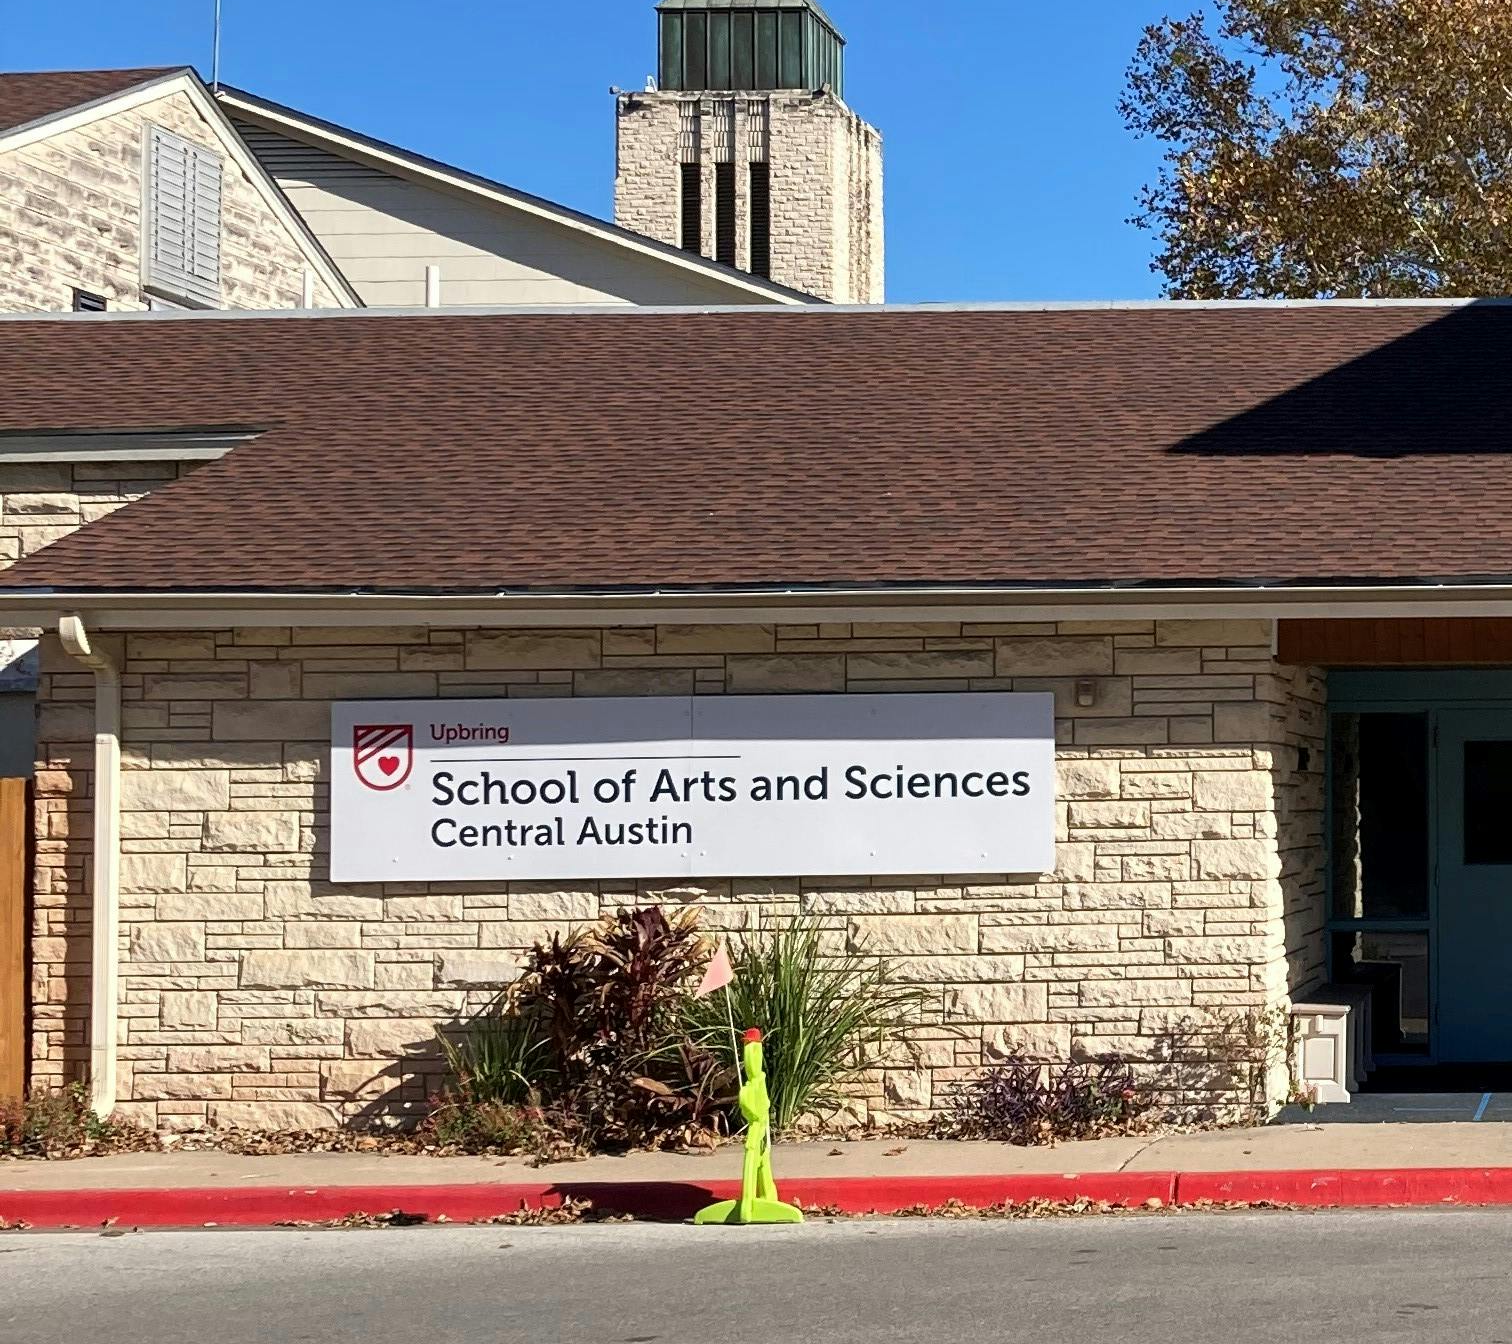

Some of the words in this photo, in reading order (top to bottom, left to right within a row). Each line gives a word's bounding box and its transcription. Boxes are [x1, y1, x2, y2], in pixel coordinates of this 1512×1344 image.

[430, 723, 509, 744] Upbring
[431, 770, 580, 806] School
[593, 768, 637, 804] of
[649, 768, 738, 803] Arts
[750, 766, 828, 802] and
[844, 764, 1031, 800] Sciences
[431, 816, 565, 848] Central
[576, 815, 692, 845] Austin
